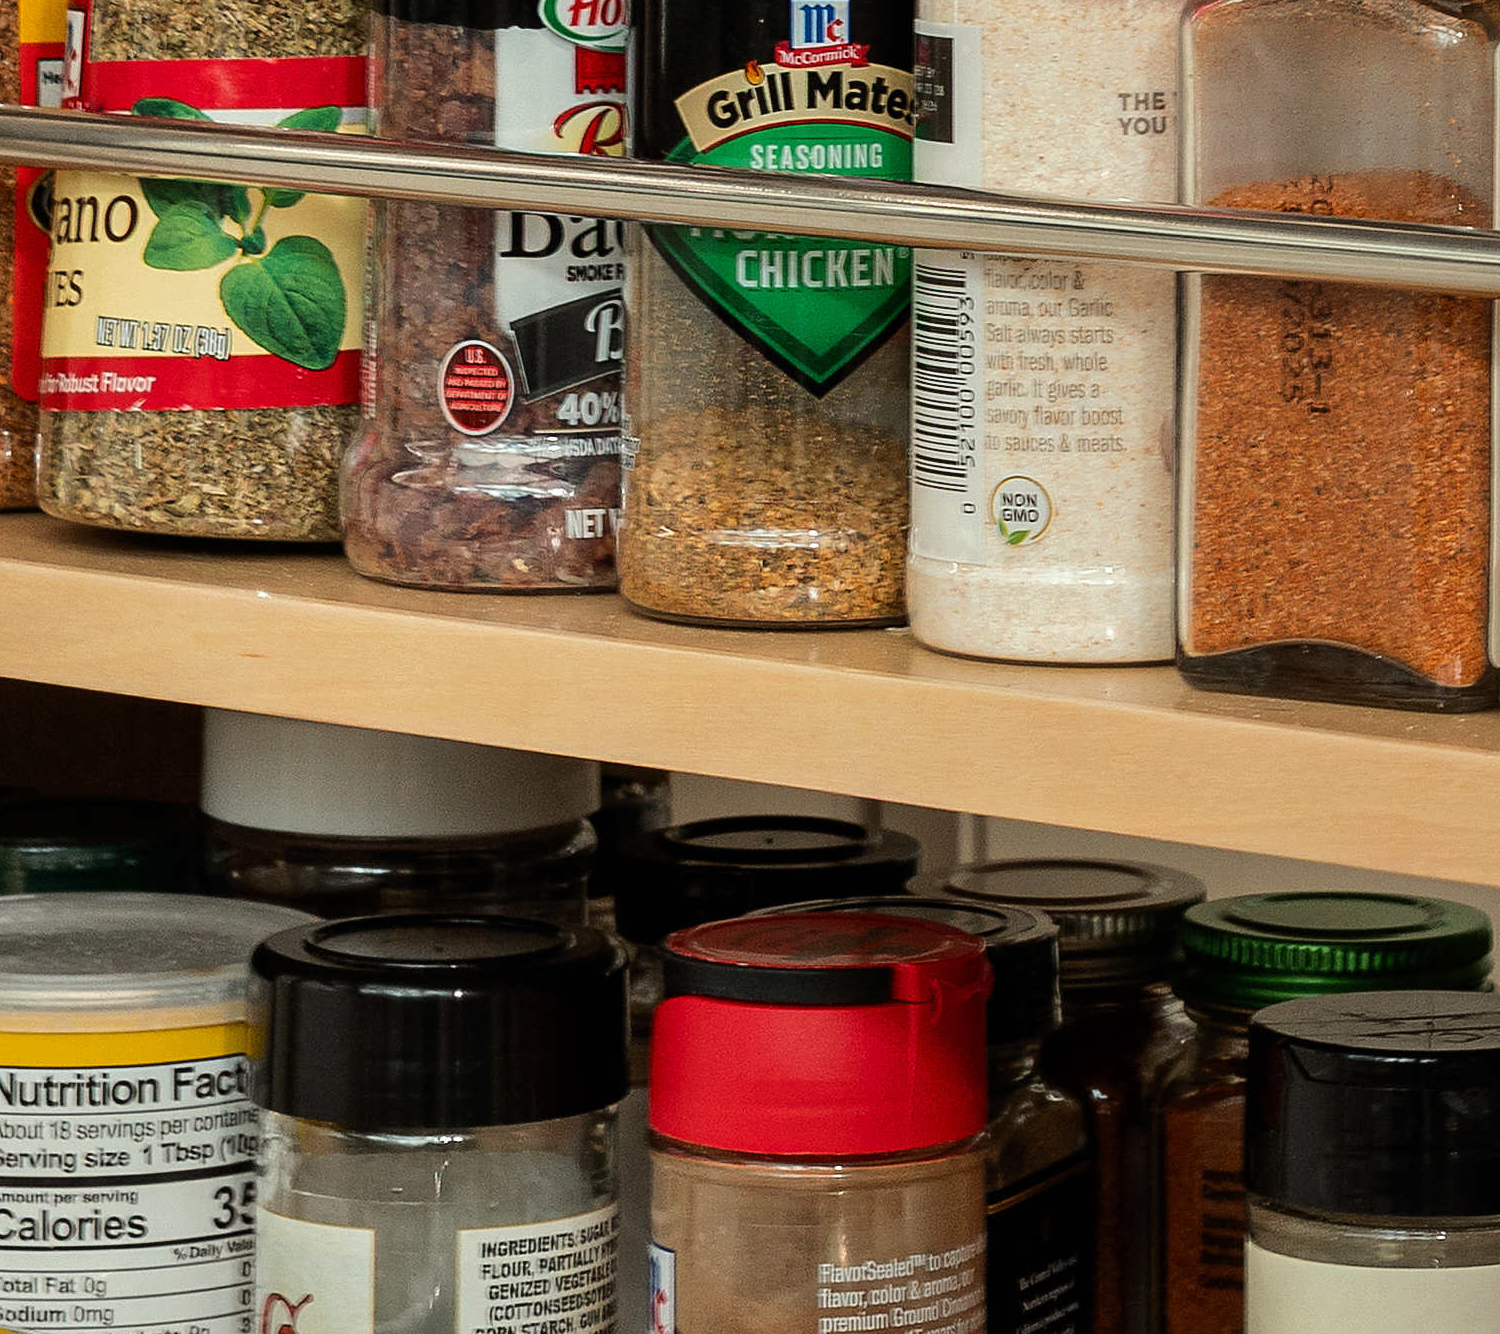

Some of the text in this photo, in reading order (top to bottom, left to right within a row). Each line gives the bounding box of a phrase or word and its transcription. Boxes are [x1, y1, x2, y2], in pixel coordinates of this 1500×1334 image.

[779, 44, 860, 67] McCormick
[707, 70, 794, 129] Grill
[1118, 92, 1166, 111] THE
[1118, 117, 1168, 136] YOU
[750, 143, 883, 170] SEASONING
[1068, 297, 1114, 317] Garlic
[96, 316, 232, 362] NET WT 1.37 OZ (38g)
[1016, 324, 1115, 348] always starts
[1018, 350, 1109, 374] fresh, whole
[101, 372, 157, 394] Flavor
[1048, 380, 1087, 403] gives
[985, 406, 1124, 429] savory flavor boost
[1004, 436, 1055, 453] sauces
[1002, 492, 1038, 507] NON
[565, 508, 607, 539] NET
[1002, 507, 1040, 524] GMO
[172, 1061, 249, 1101] Fact
[50, 1120, 72, 1141] 18
[76, 1118, 156, 1143] servings
[160, 1117, 189, 1141] per
[84, 1147, 132, 1168] size
[160, 1141, 215, 1165] Tbsp
[82, 1189, 140, 1206] serving
[481, 1232, 578, 1259] INGREDIENTS:
[481, 1247, 601, 1281] FLOUR, PARTIALLY
[45, 1276, 76, 1294] Fat
[489, 1279, 550, 1301] GENIZED
[818, 1284, 907, 1310] flavor, color
[73, 1305, 115, 1325] 0mg
[892, 1301, 939, 1328] Ground
